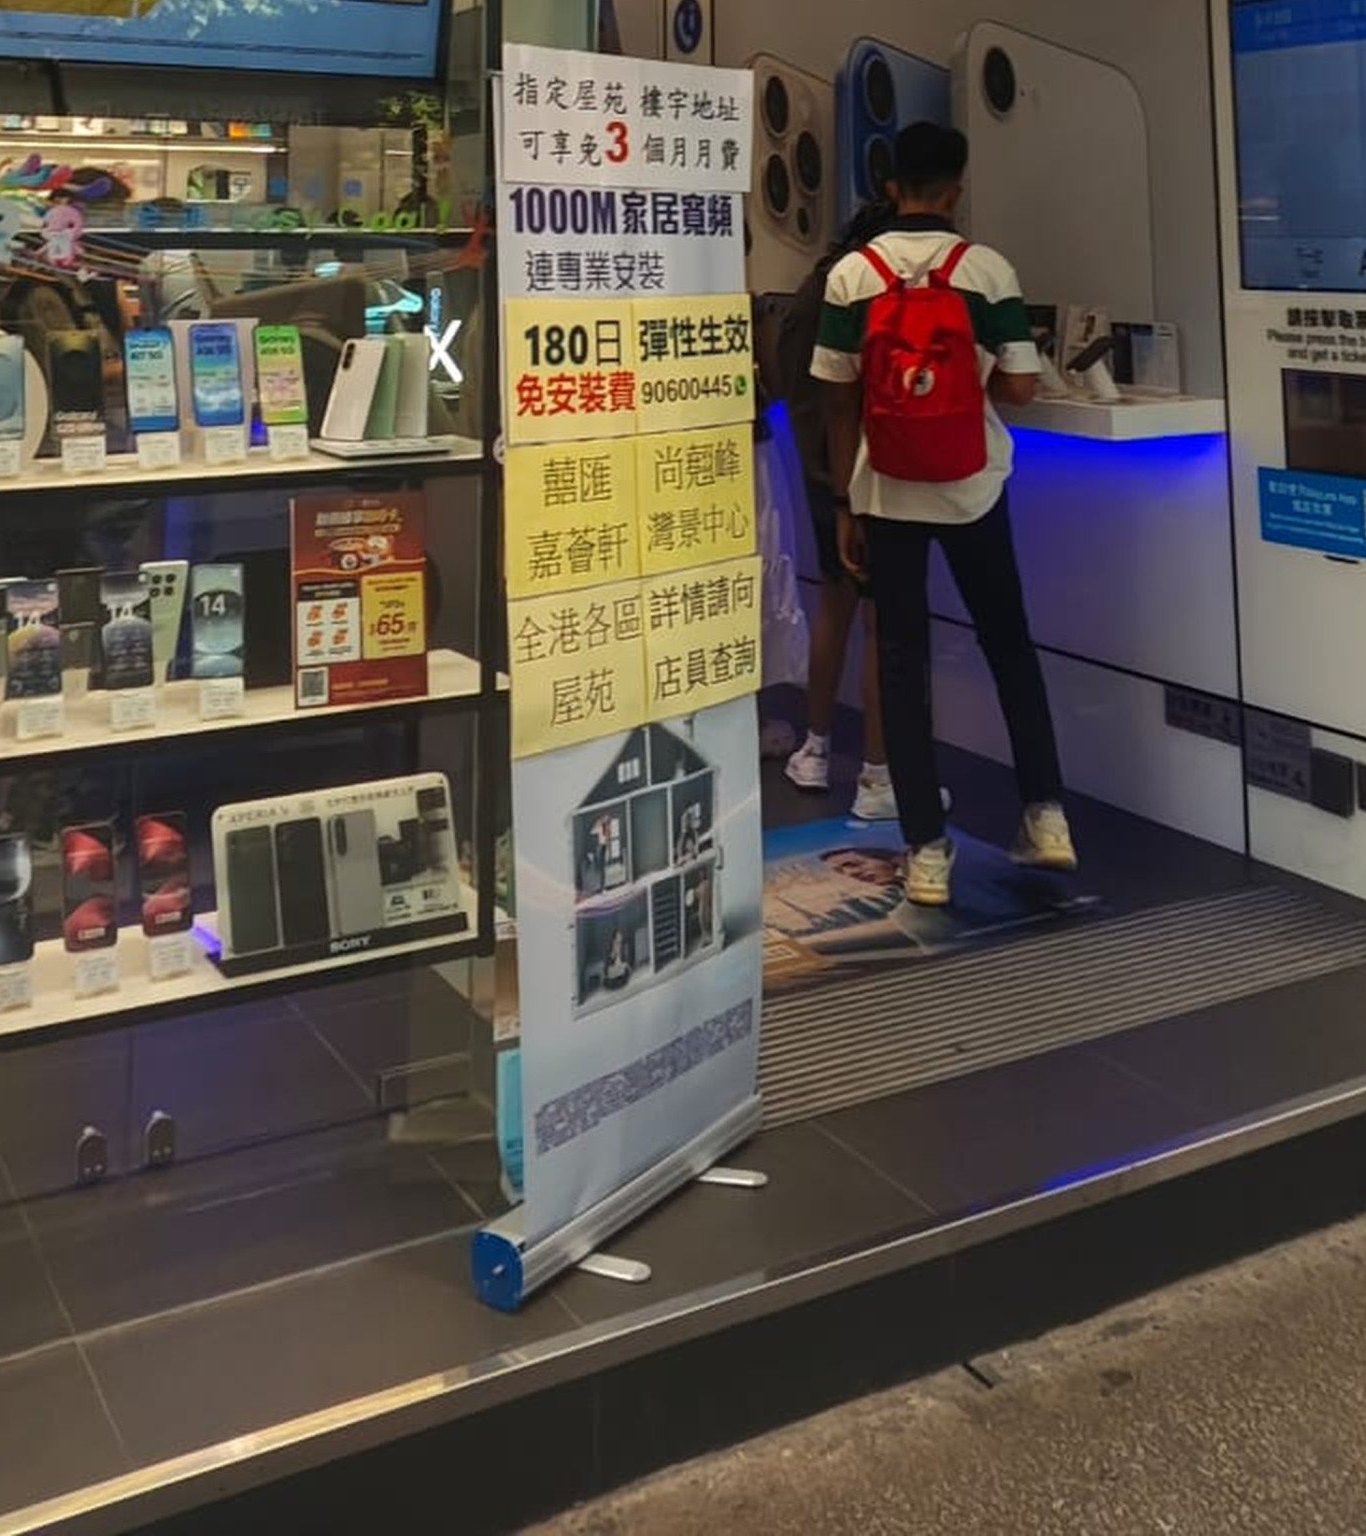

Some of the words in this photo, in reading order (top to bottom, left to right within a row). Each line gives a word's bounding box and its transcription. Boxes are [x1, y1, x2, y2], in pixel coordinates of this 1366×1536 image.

[513, 73, 627, 116] 指定屋苑
[640, 85, 740, 121] 樓宇地址
[525, 249, 665, 292] 連專業安裝
[516, 372, 637, 417] 免安裝費
[642, 374, 733, 404] 90600445
[528, 522, 629, 582] 嘉薈軒
[647, 502, 749, 553] 灣景中心
[513, 594, 644, 664] 全港各區
[650, 572, 756, 630] 詳情請向
[550, 666, 616, 728] 屋苑
[654, 635, 757, 702] 店員查詢
